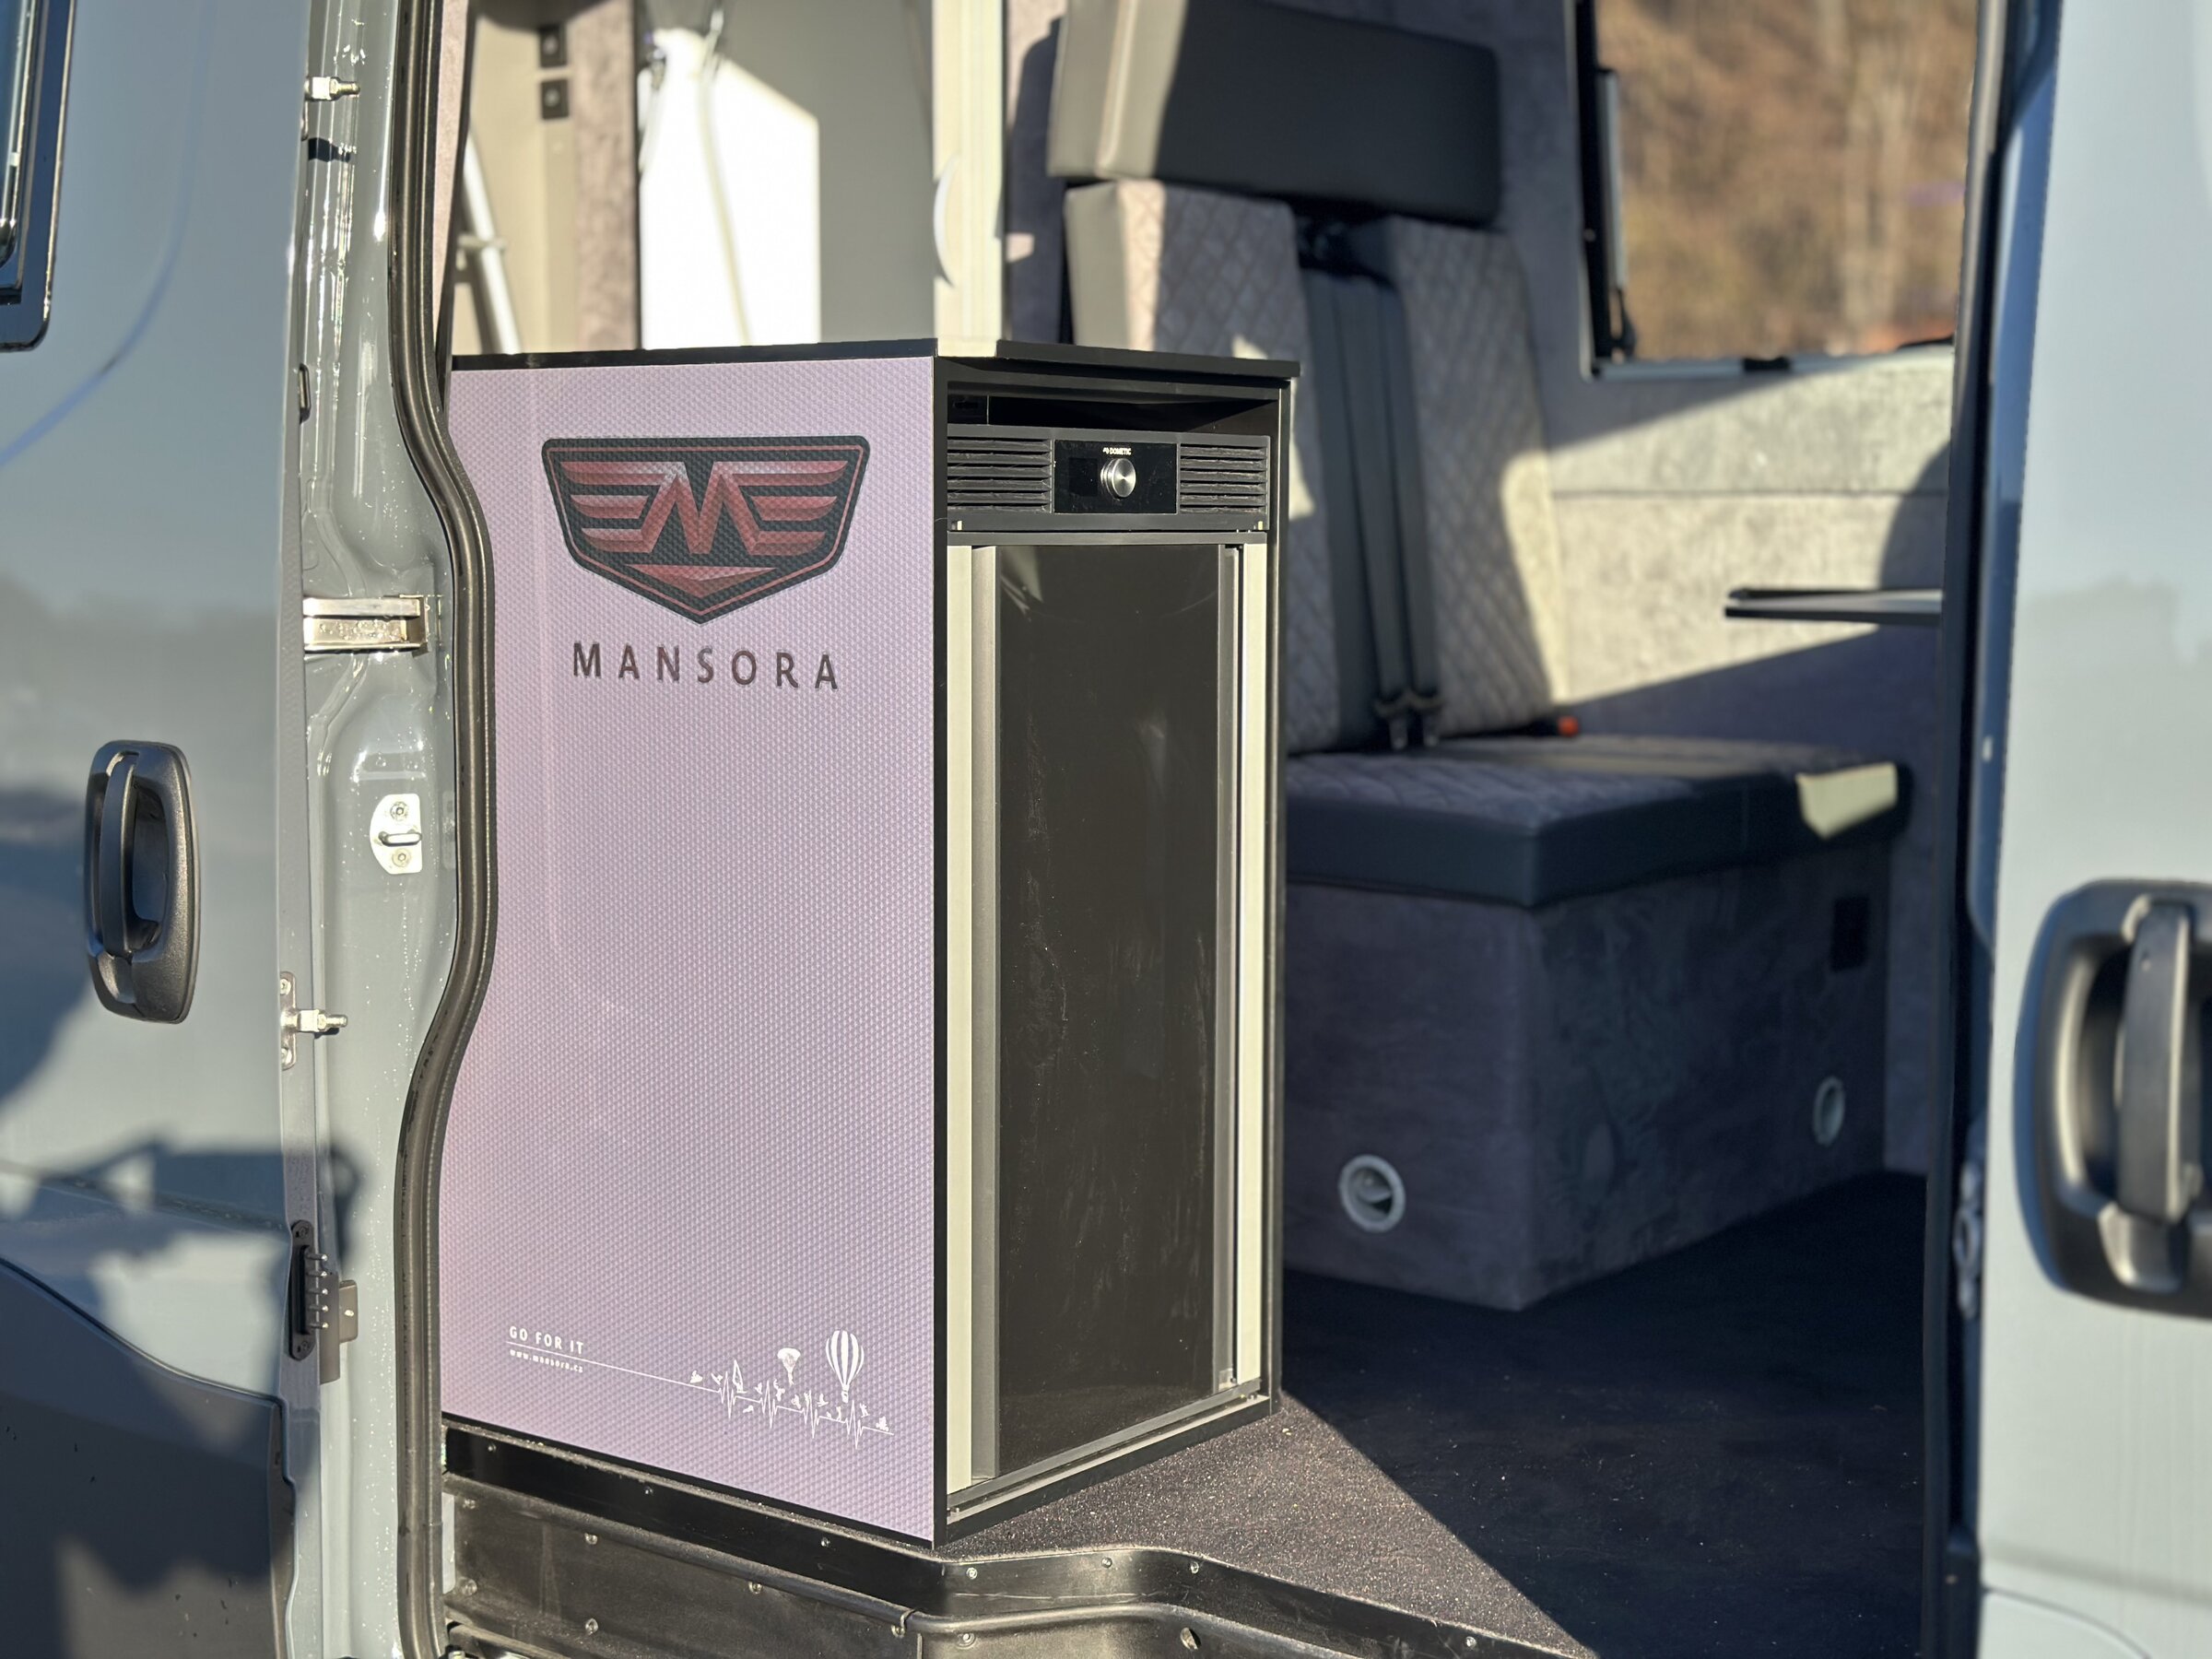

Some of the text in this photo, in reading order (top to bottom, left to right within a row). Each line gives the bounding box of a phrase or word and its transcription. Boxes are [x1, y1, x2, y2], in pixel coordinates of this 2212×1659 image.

[1109, 447, 1132, 456] DOMETIC
[571, 641, 839, 691] MANSORA
[509, 1325, 584, 1356] GO FOR IT
